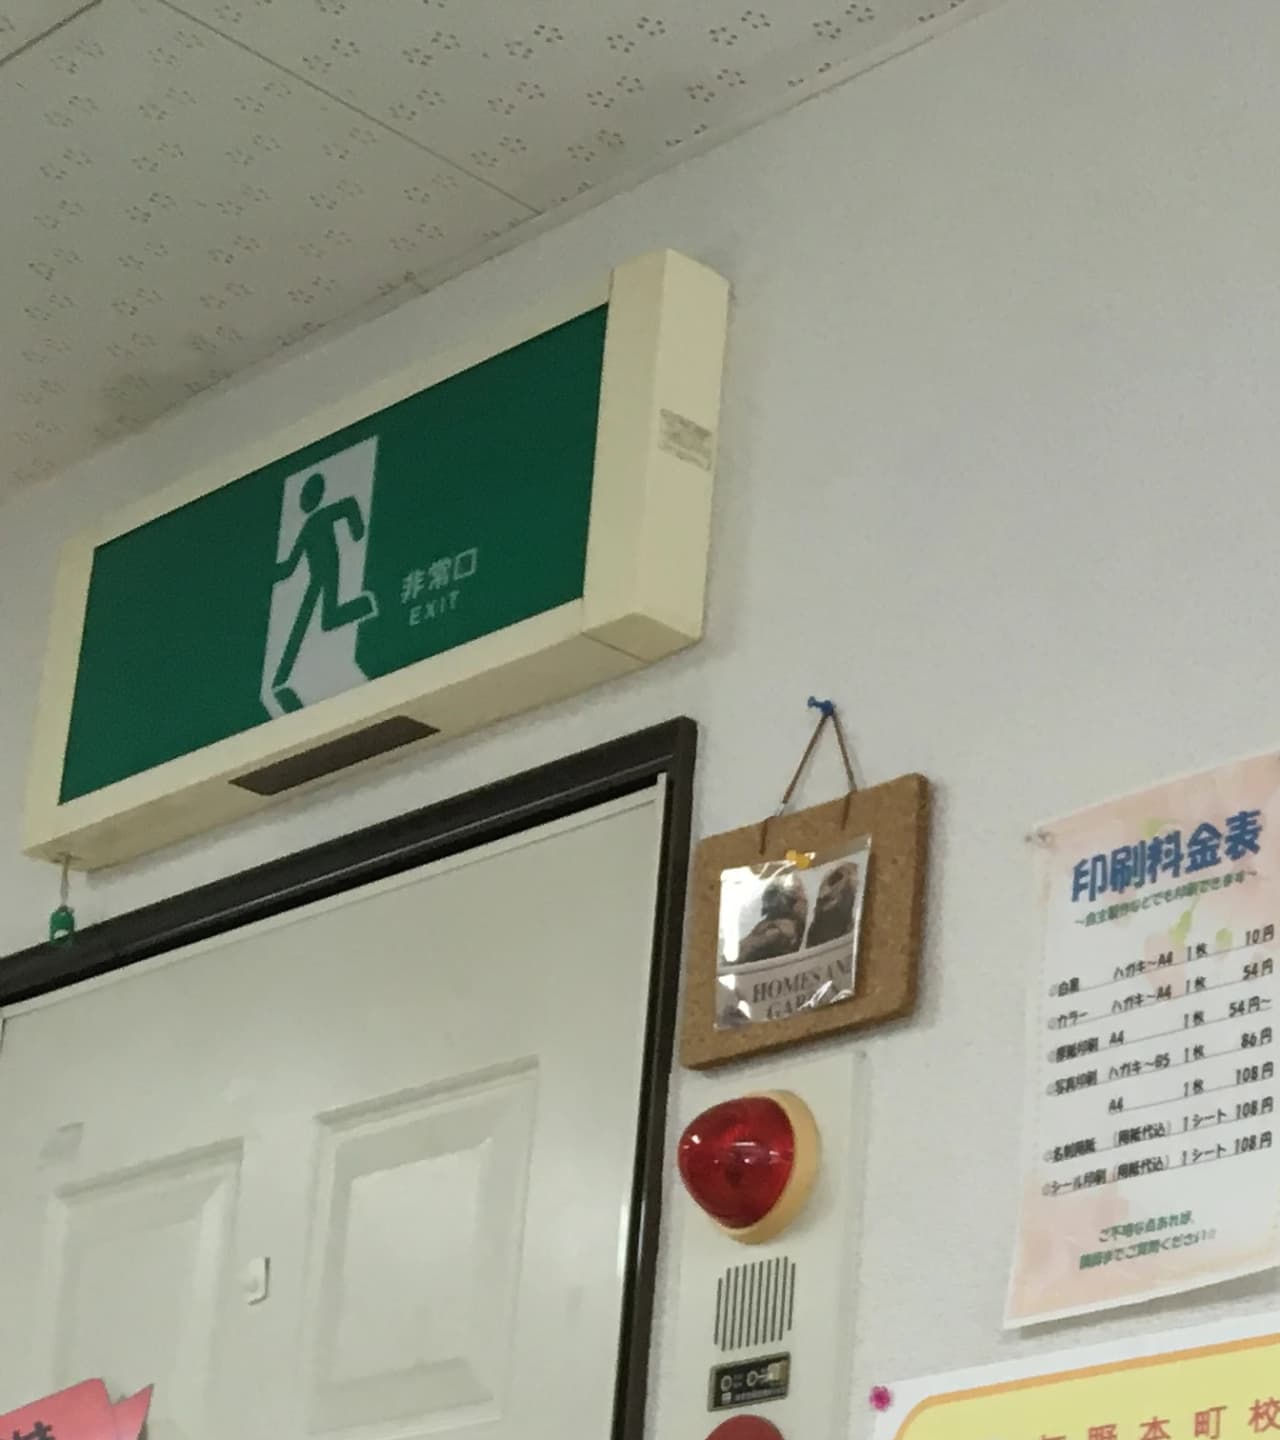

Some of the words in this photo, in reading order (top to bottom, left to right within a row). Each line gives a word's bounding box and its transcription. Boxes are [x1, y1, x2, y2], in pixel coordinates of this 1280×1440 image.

[401, 548, 478, 603] 非常口
[409, 591, 460, 626] EXIT
[1071, 810, 1262, 903] 印刷料金表
